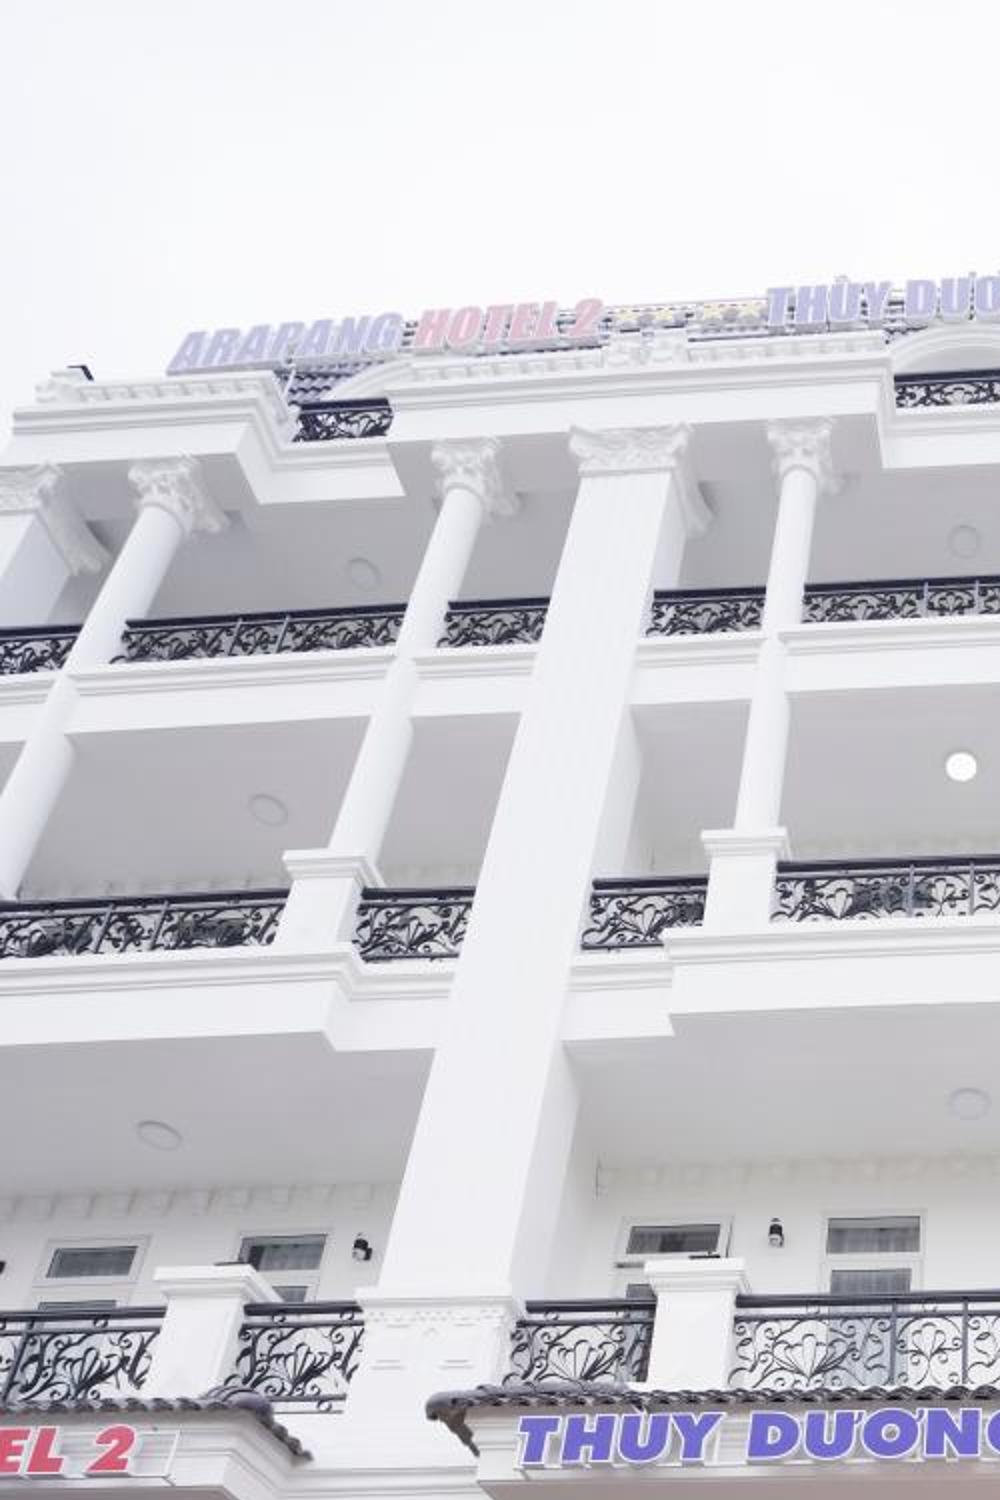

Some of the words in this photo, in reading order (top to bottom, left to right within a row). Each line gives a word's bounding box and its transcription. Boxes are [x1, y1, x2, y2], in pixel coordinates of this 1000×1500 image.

[166, 312, 404, 373] ARAPANG
[414, 301, 559, 349] HOTEL
[568, 298, 604, 339] 2
[84, 1423, 138, 1473] 2
